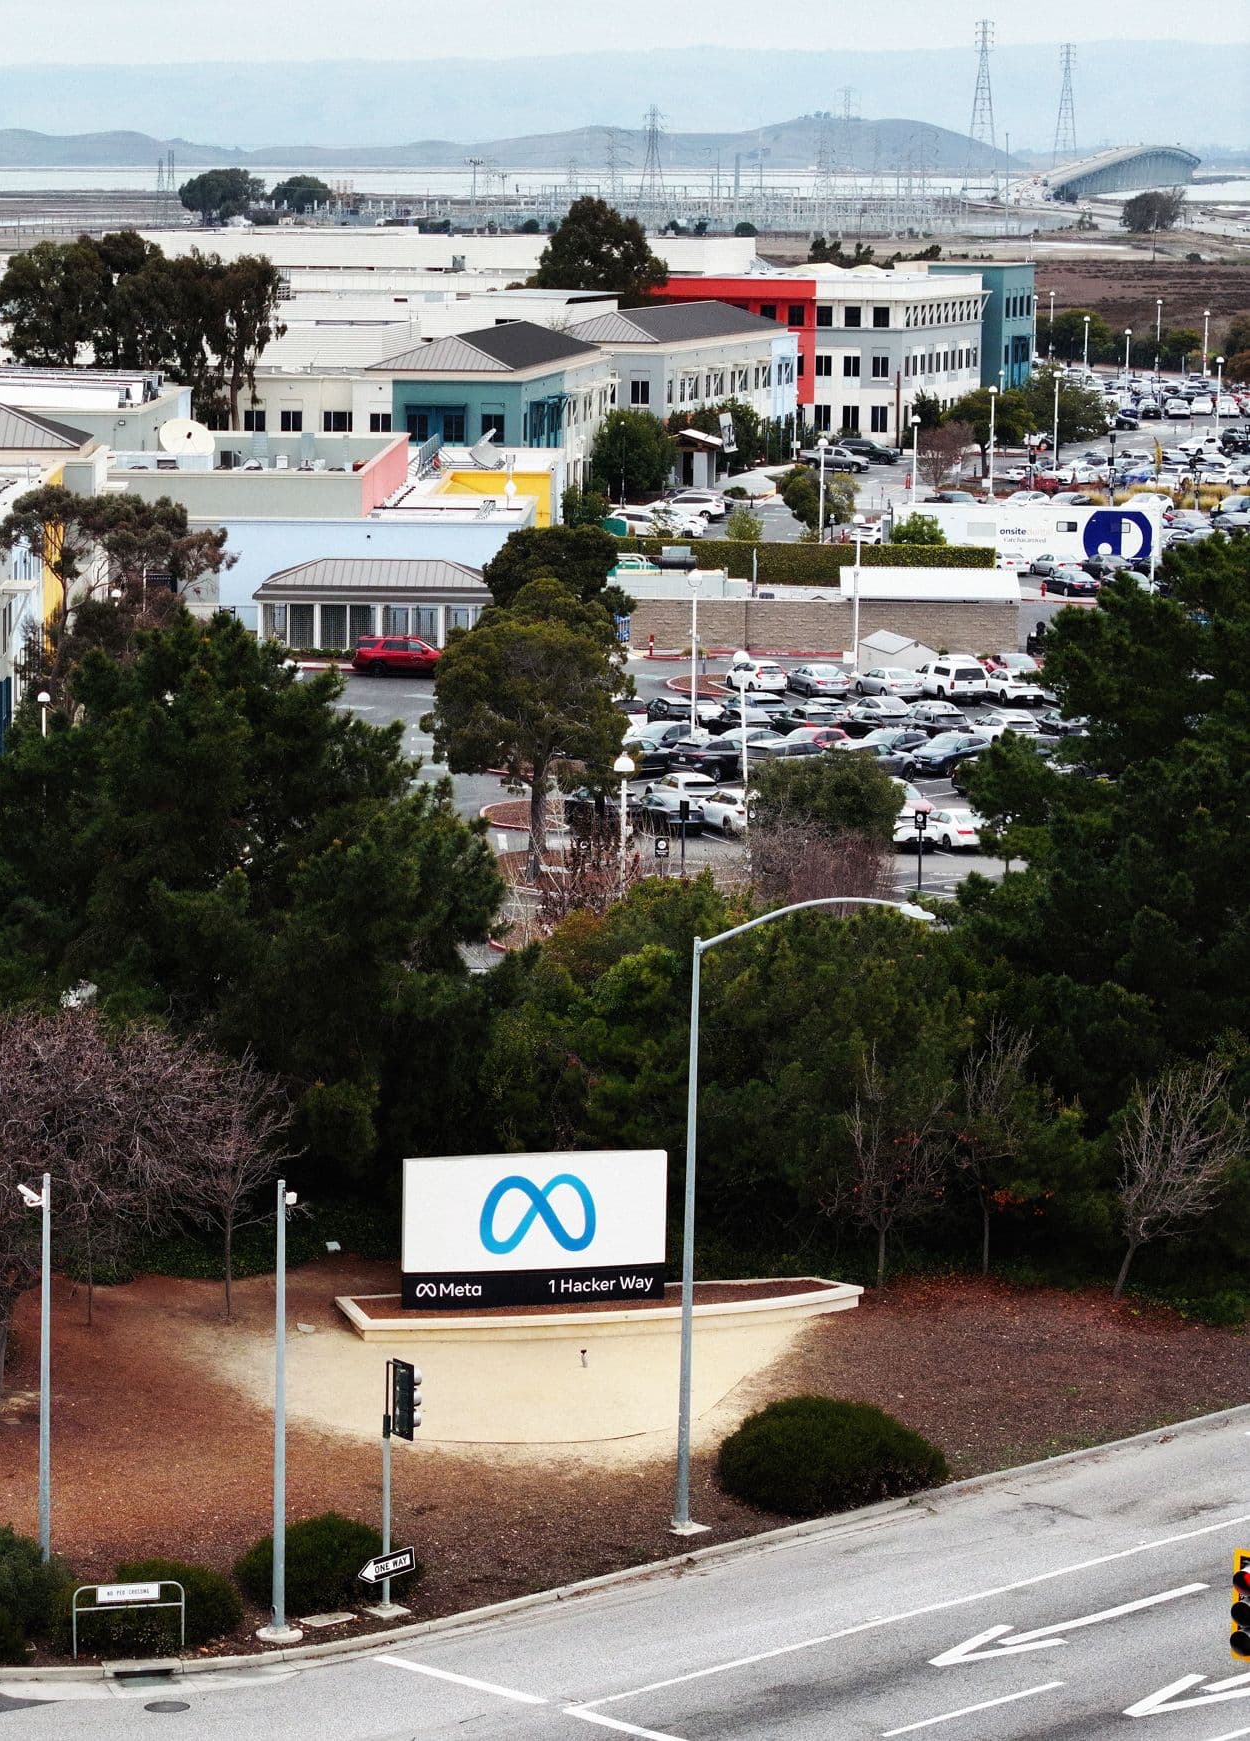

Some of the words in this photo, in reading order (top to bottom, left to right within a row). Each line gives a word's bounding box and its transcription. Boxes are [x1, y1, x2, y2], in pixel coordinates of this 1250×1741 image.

[999, 526, 1027, 535] onsite
[439, 1283, 482, 1297] Meta
[548, 1280, 555, 1294] 1
[560, 1277, 616, 1293] Hacker
[619, 1275, 654, 1292] Way
[374, 1562, 390, 1574] ONE
[392, 1556, 407, 1568] WAY
